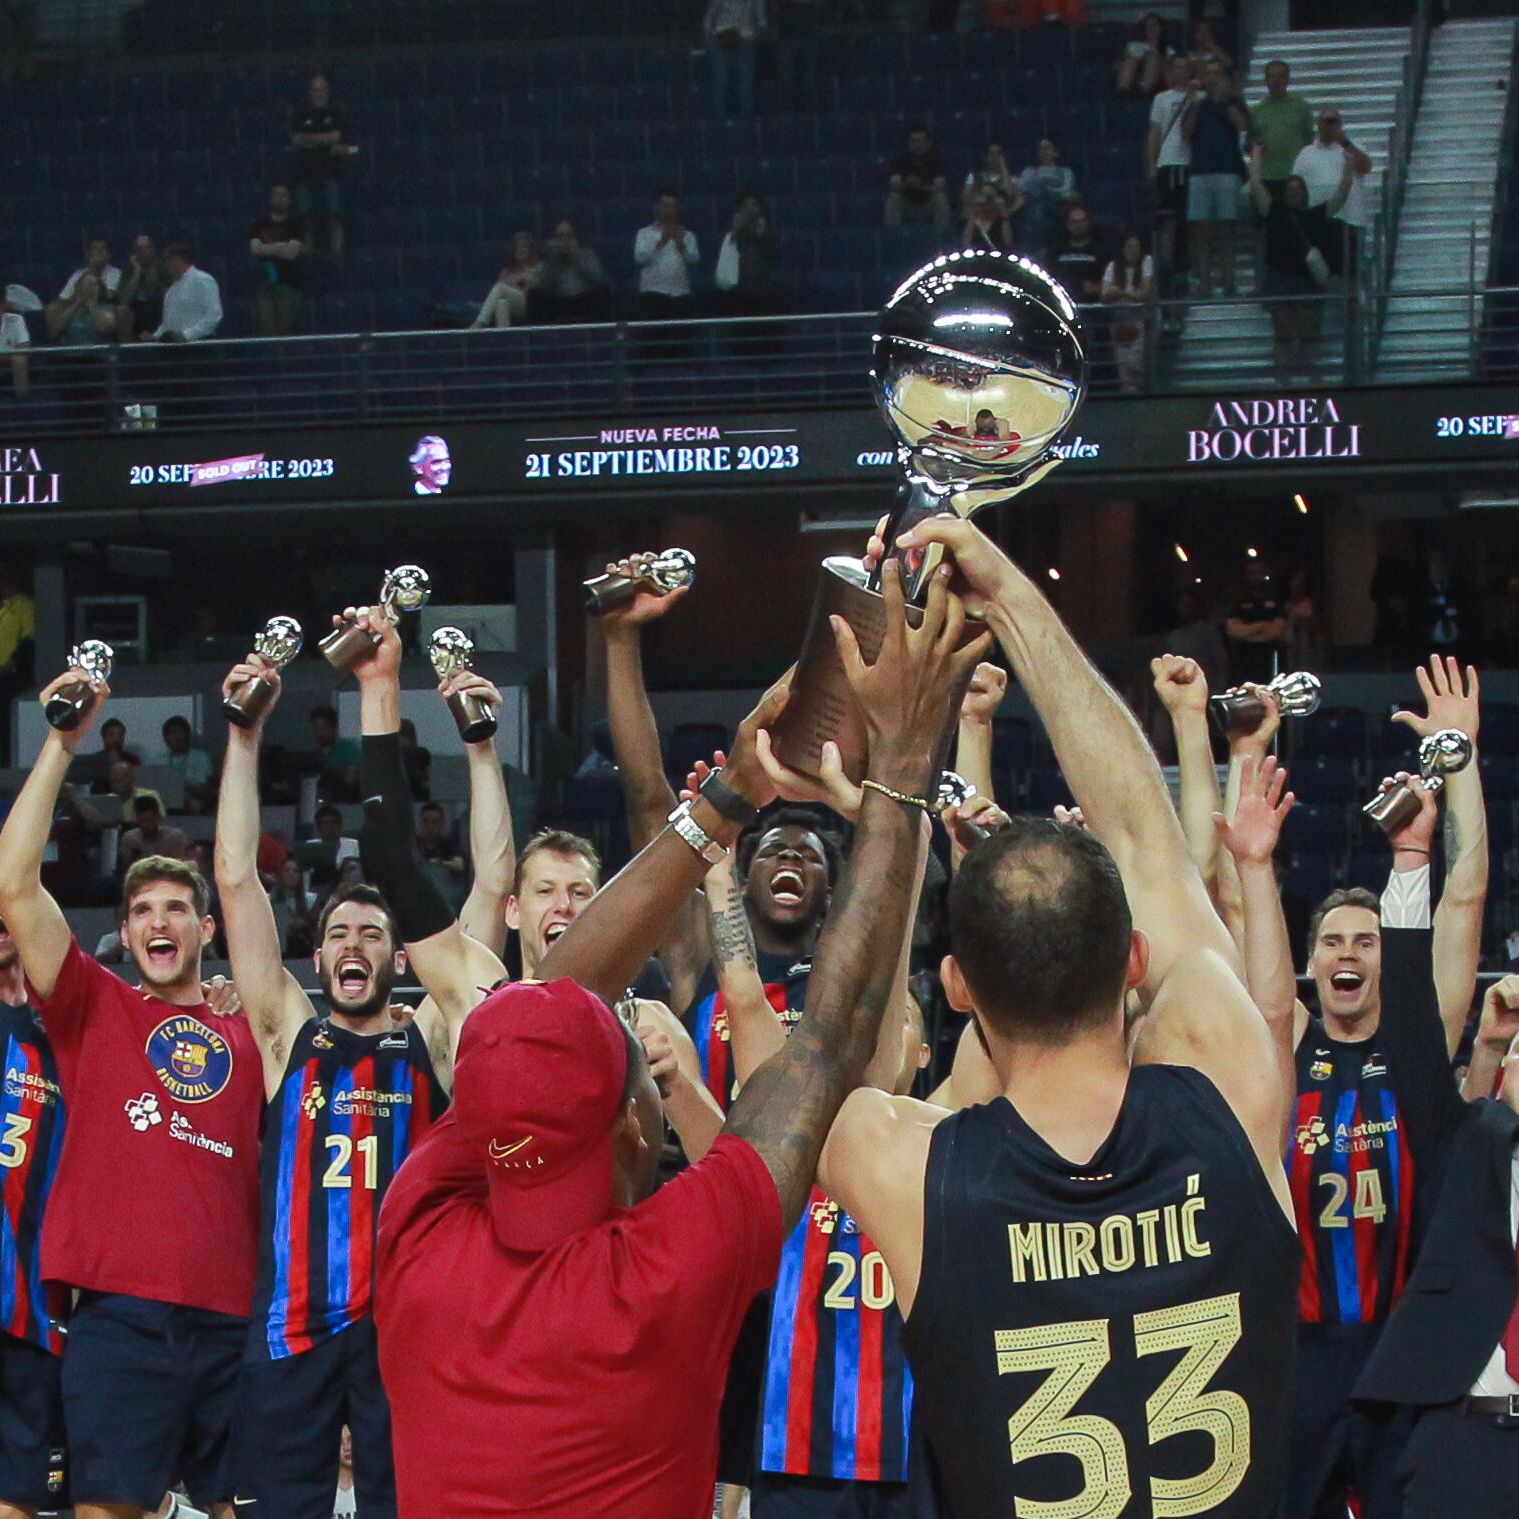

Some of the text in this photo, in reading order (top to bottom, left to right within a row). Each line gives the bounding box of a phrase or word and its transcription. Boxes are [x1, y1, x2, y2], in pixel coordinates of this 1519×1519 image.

[1212, 399, 1341, 427] ANDREA
[1436, 417, 1463, 437] 20
[601, 426, 720, 444] NUEVA FECHA
[1186, 425, 1361, 462] BOCELLI
[129, 466, 154, 484] 20
[287, 458, 333, 478] 2023
[197, 465, 230, 480] SOLD
[525, 445, 800, 478] 21 SEPTIEMBRE 2023
[857, 450, 893, 465] con
[159, 1020, 226, 1054] FC BARCELONA
[156, 1067, 213, 1097] BASKETBALL
[322, 1134, 378, 1190] 21
[1319, 1168, 1387, 1228] 24
[1008, 1175, 1211, 1283] MIROTIĆ
[824, 1251, 895, 1310] 20
